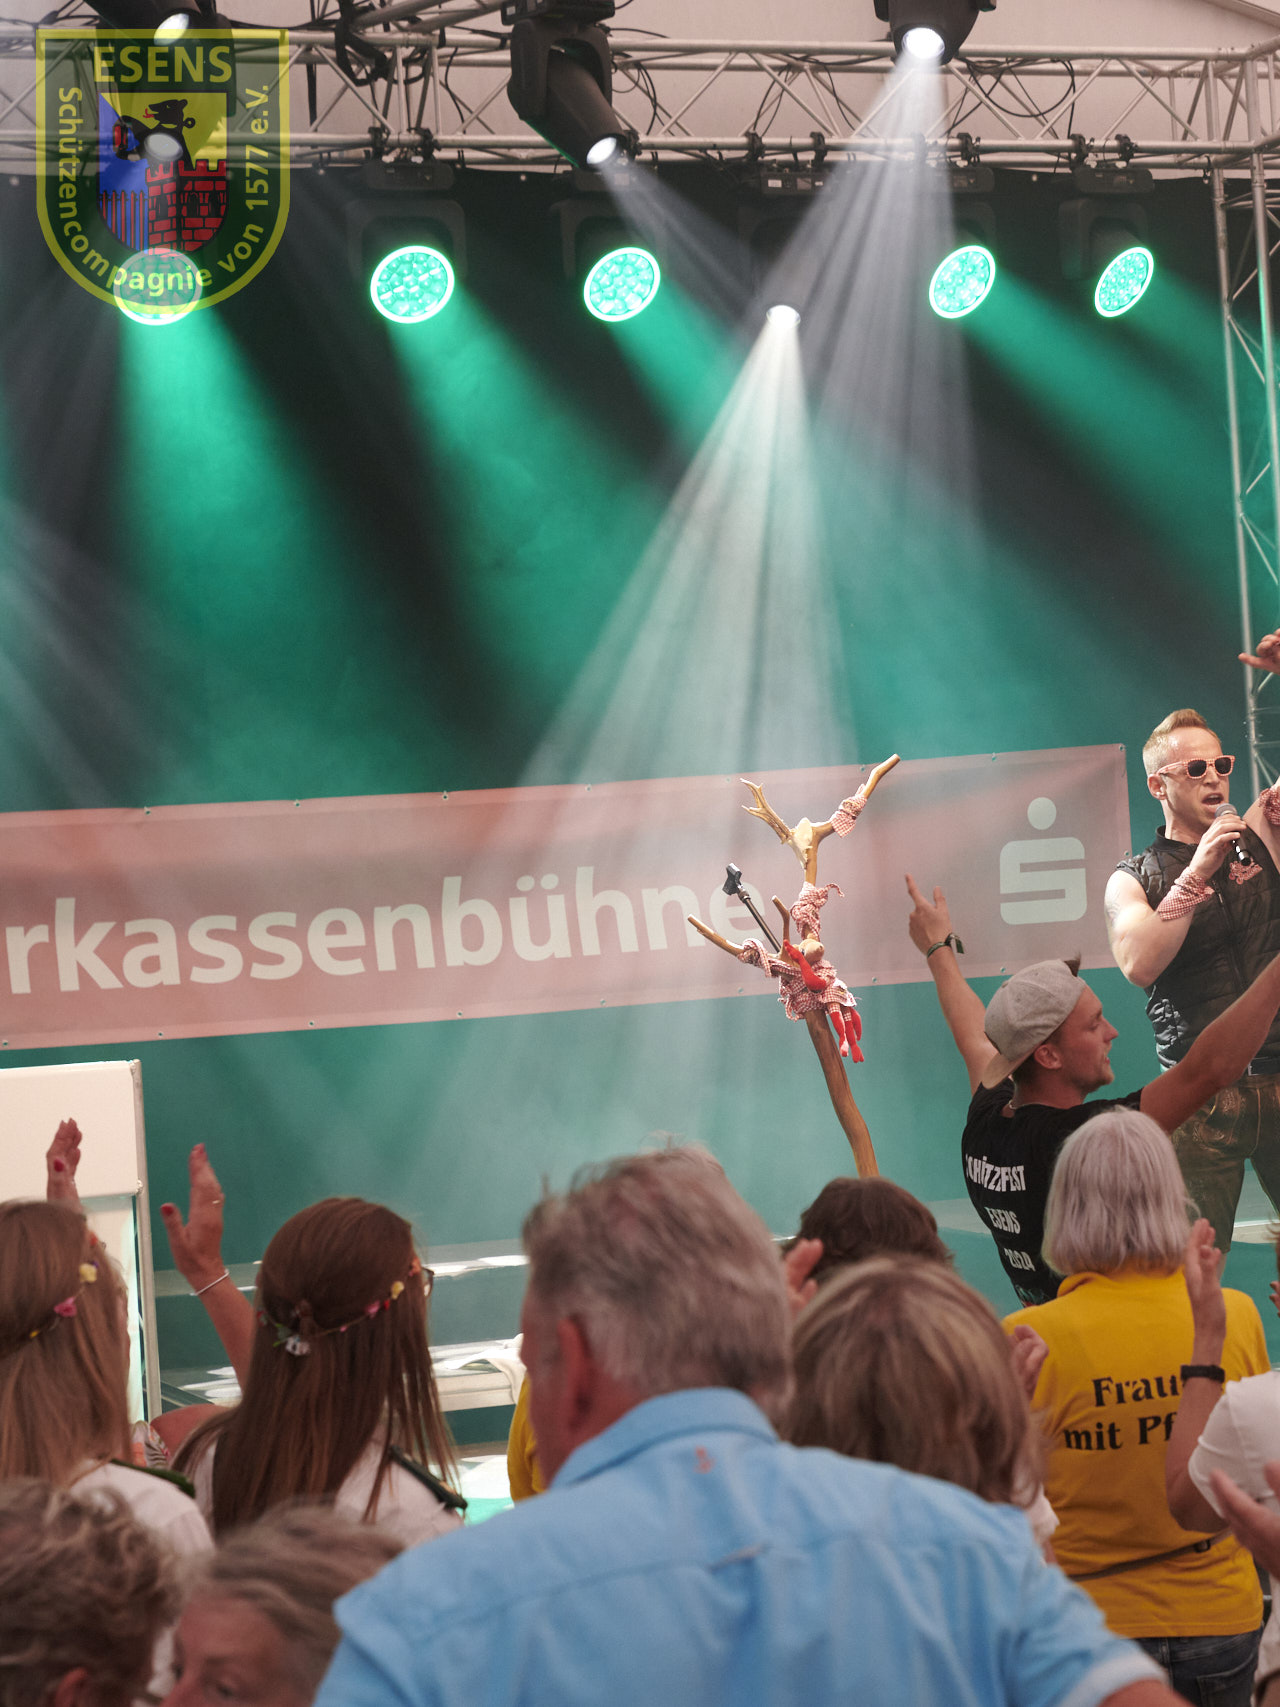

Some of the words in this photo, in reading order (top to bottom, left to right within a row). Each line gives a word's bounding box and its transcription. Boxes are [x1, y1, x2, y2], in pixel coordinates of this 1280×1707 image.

[4, 866, 766, 995] rkassenbühne
[1092, 1375, 1187, 1408] Frau
[1064, 1421, 1123, 1451] mit
